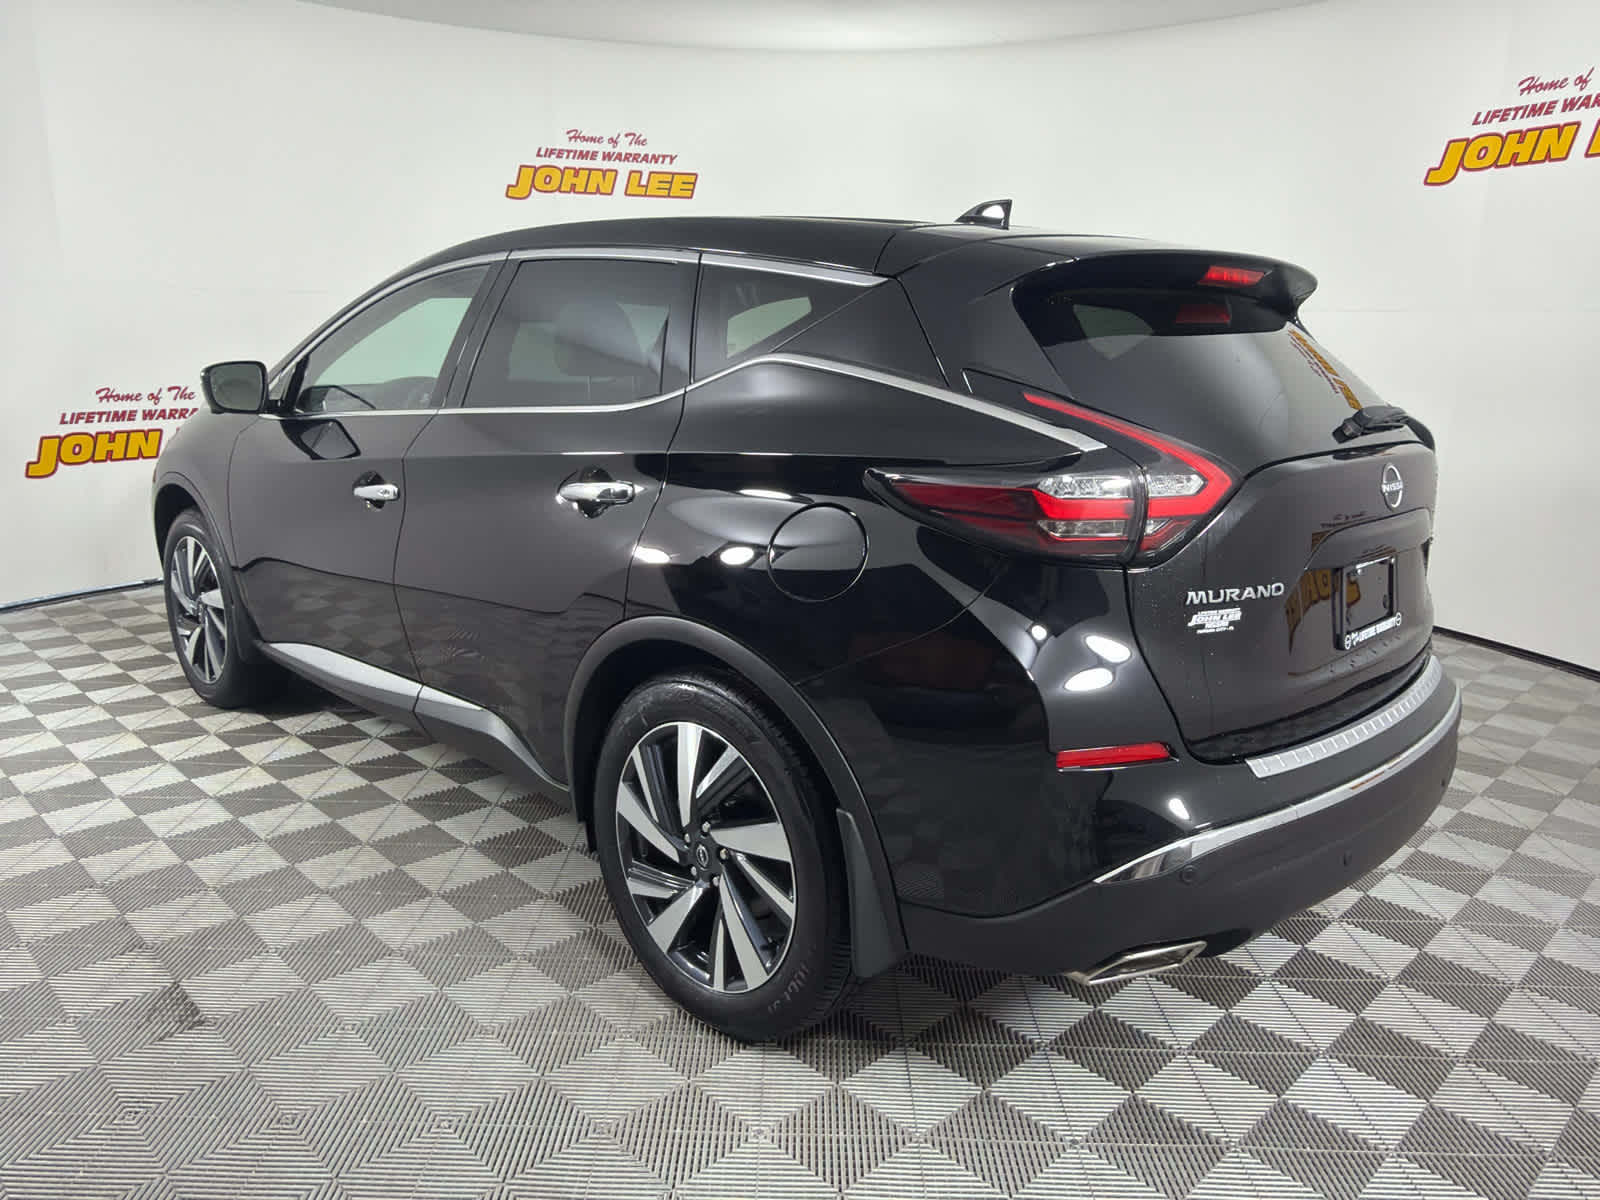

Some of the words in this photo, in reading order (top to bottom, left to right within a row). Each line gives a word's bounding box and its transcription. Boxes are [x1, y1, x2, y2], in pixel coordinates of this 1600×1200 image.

[1518, 75, 1569, 96] Home
[1573, 66, 1595, 91] of
[1471, 99, 1559, 126] LIFETIME
[566, 128, 604, 145] Home
[607, 133, 621, 148] of
[624, 132, 648, 147] The
[536, 147, 599, 161] LIFETIME
[601, 151, 678, 165] WARRANTY
[1423, 121, 1582, 187] JOHN
[505, 164, 618, 200] JOHN
[624, 170, 698, 200] LEE
[95, 387, 143, 403] Home
[147, 387, 162, 406] of
[167, 386, 197, 401] The
[59, 409, 138, 425] LIFETIME
[25, 428, 163, 479] JOHN
[1185, 582, 1285, 605] MURANO
